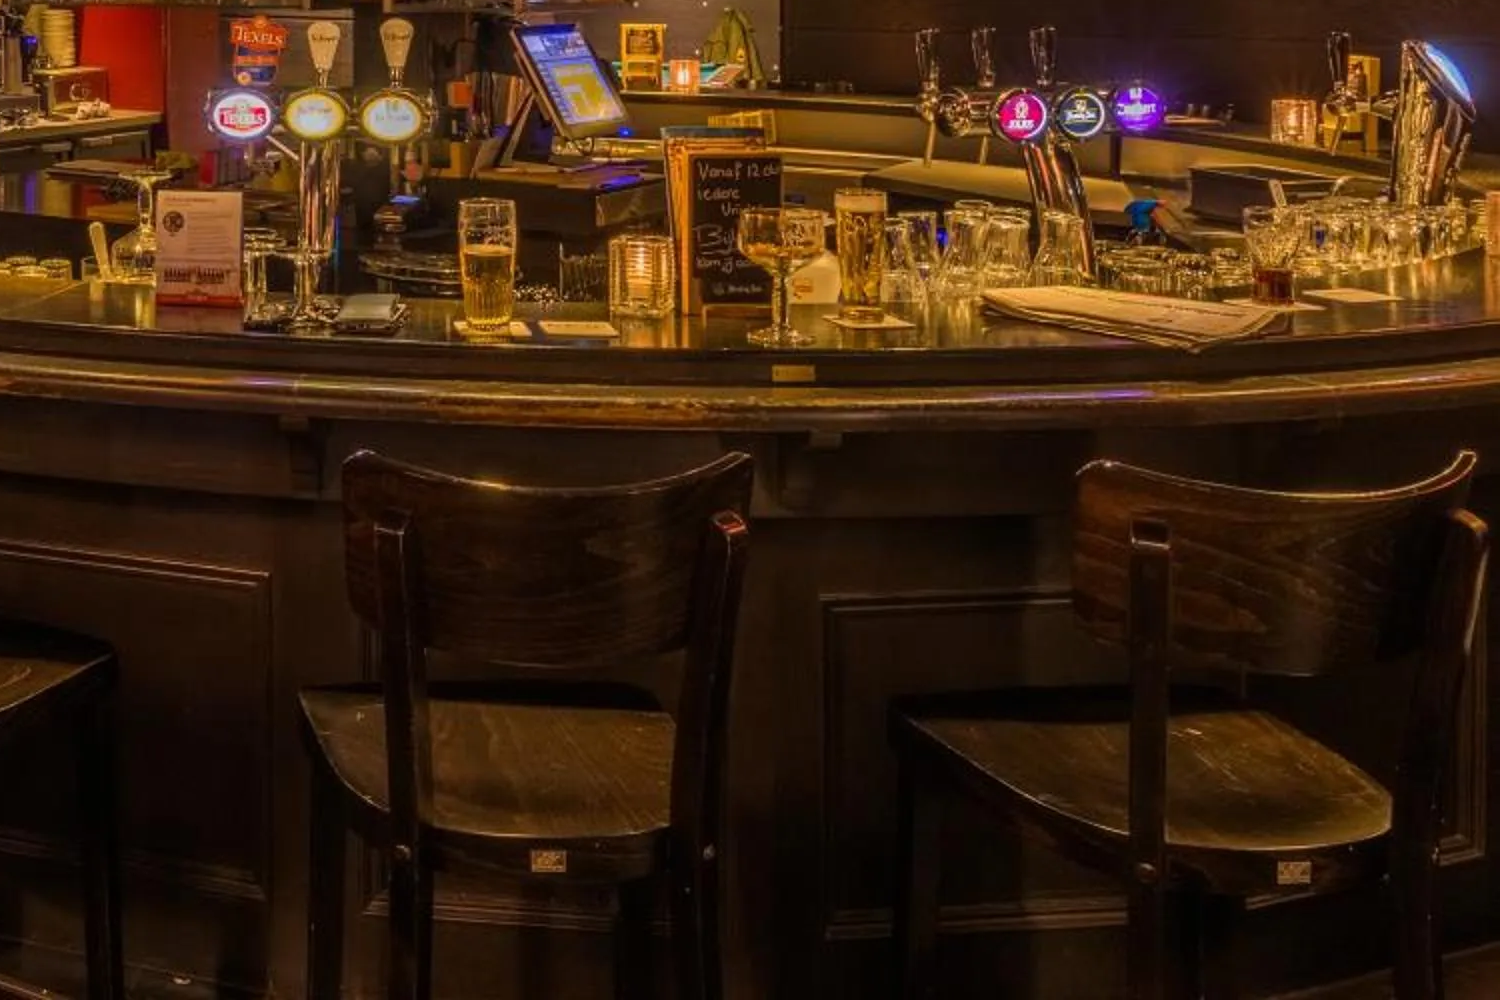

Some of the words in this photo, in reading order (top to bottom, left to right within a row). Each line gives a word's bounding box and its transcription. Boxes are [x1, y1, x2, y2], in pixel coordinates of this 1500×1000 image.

[231, 25, 285, 44] TEXELS
[220, 110, 265, 124] TEXELS
[698, 161, 742, 180] Vanaf
[747, 162, 760, 177] 12
